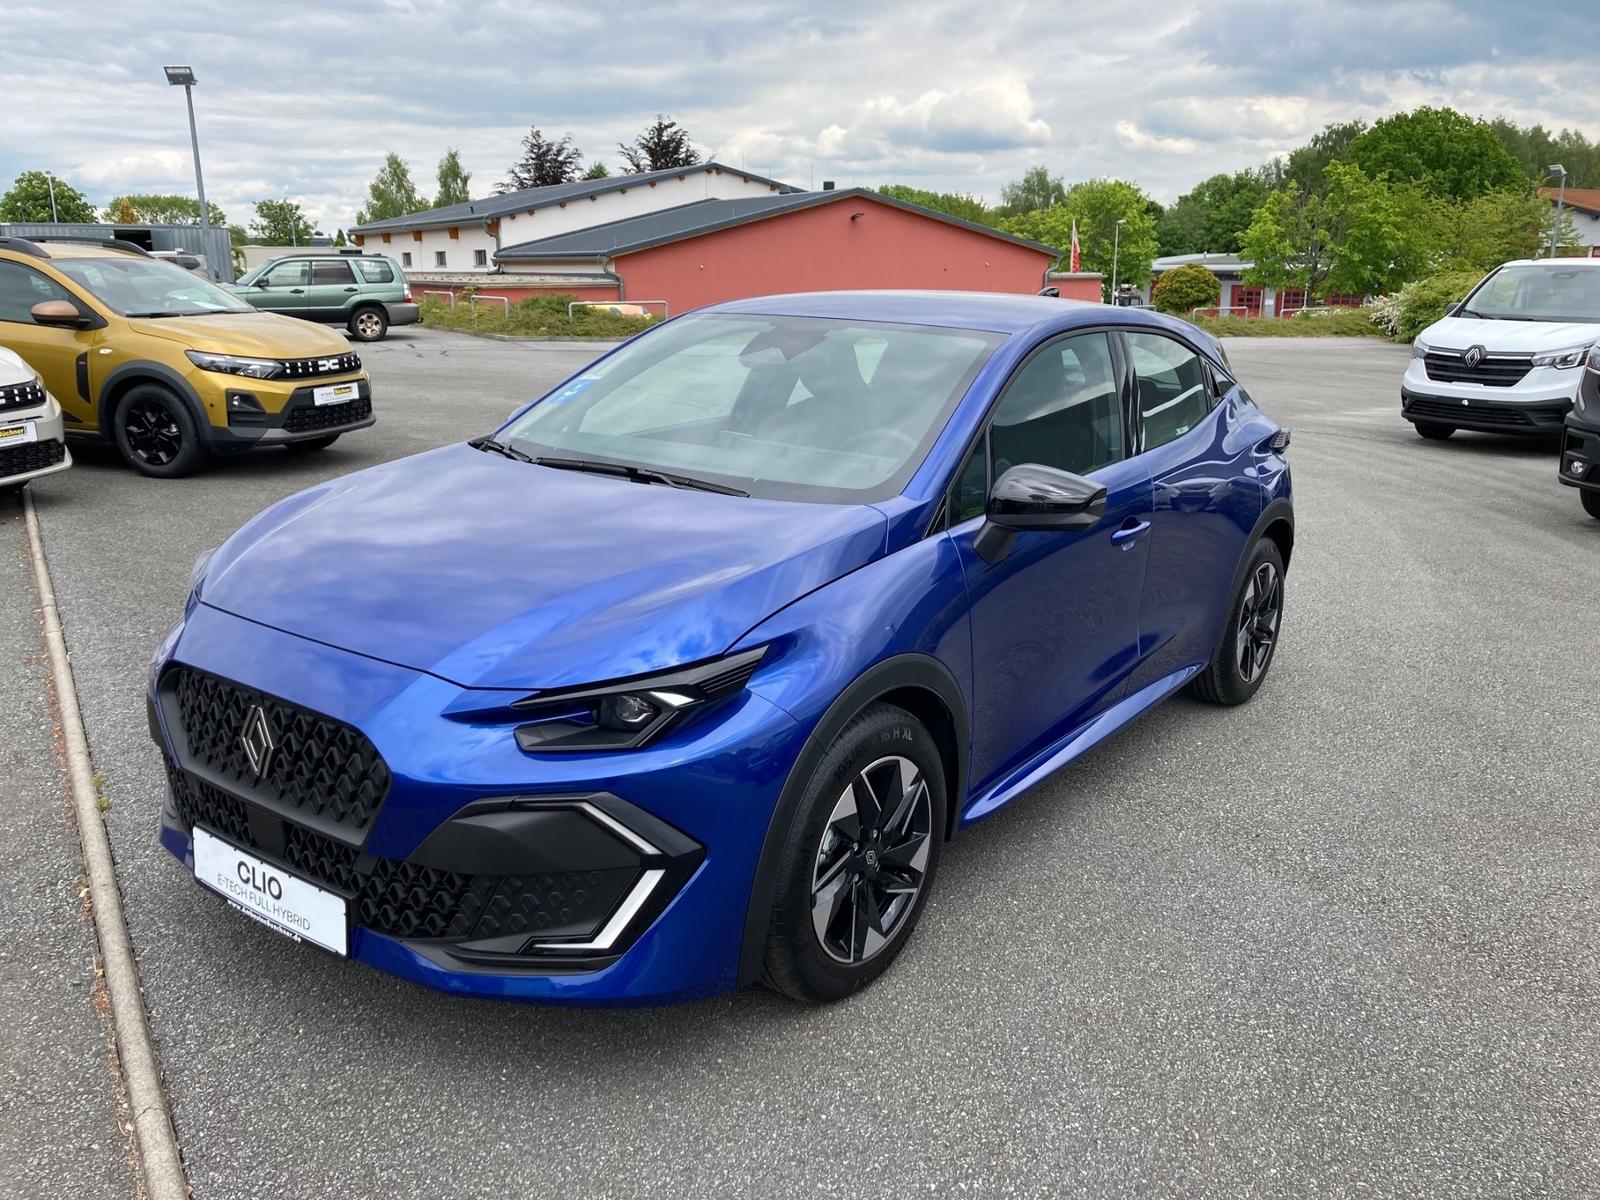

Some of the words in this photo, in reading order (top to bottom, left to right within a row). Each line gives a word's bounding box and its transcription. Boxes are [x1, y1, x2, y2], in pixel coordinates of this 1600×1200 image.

[902, 726, 913, 741] XL
[237, 860, 282, 900] CLIO
[216, 873, 249, 902] E-TECH
[249, 890, 274, 914] FULL
[273, 904, 311, 932] HYBRID
